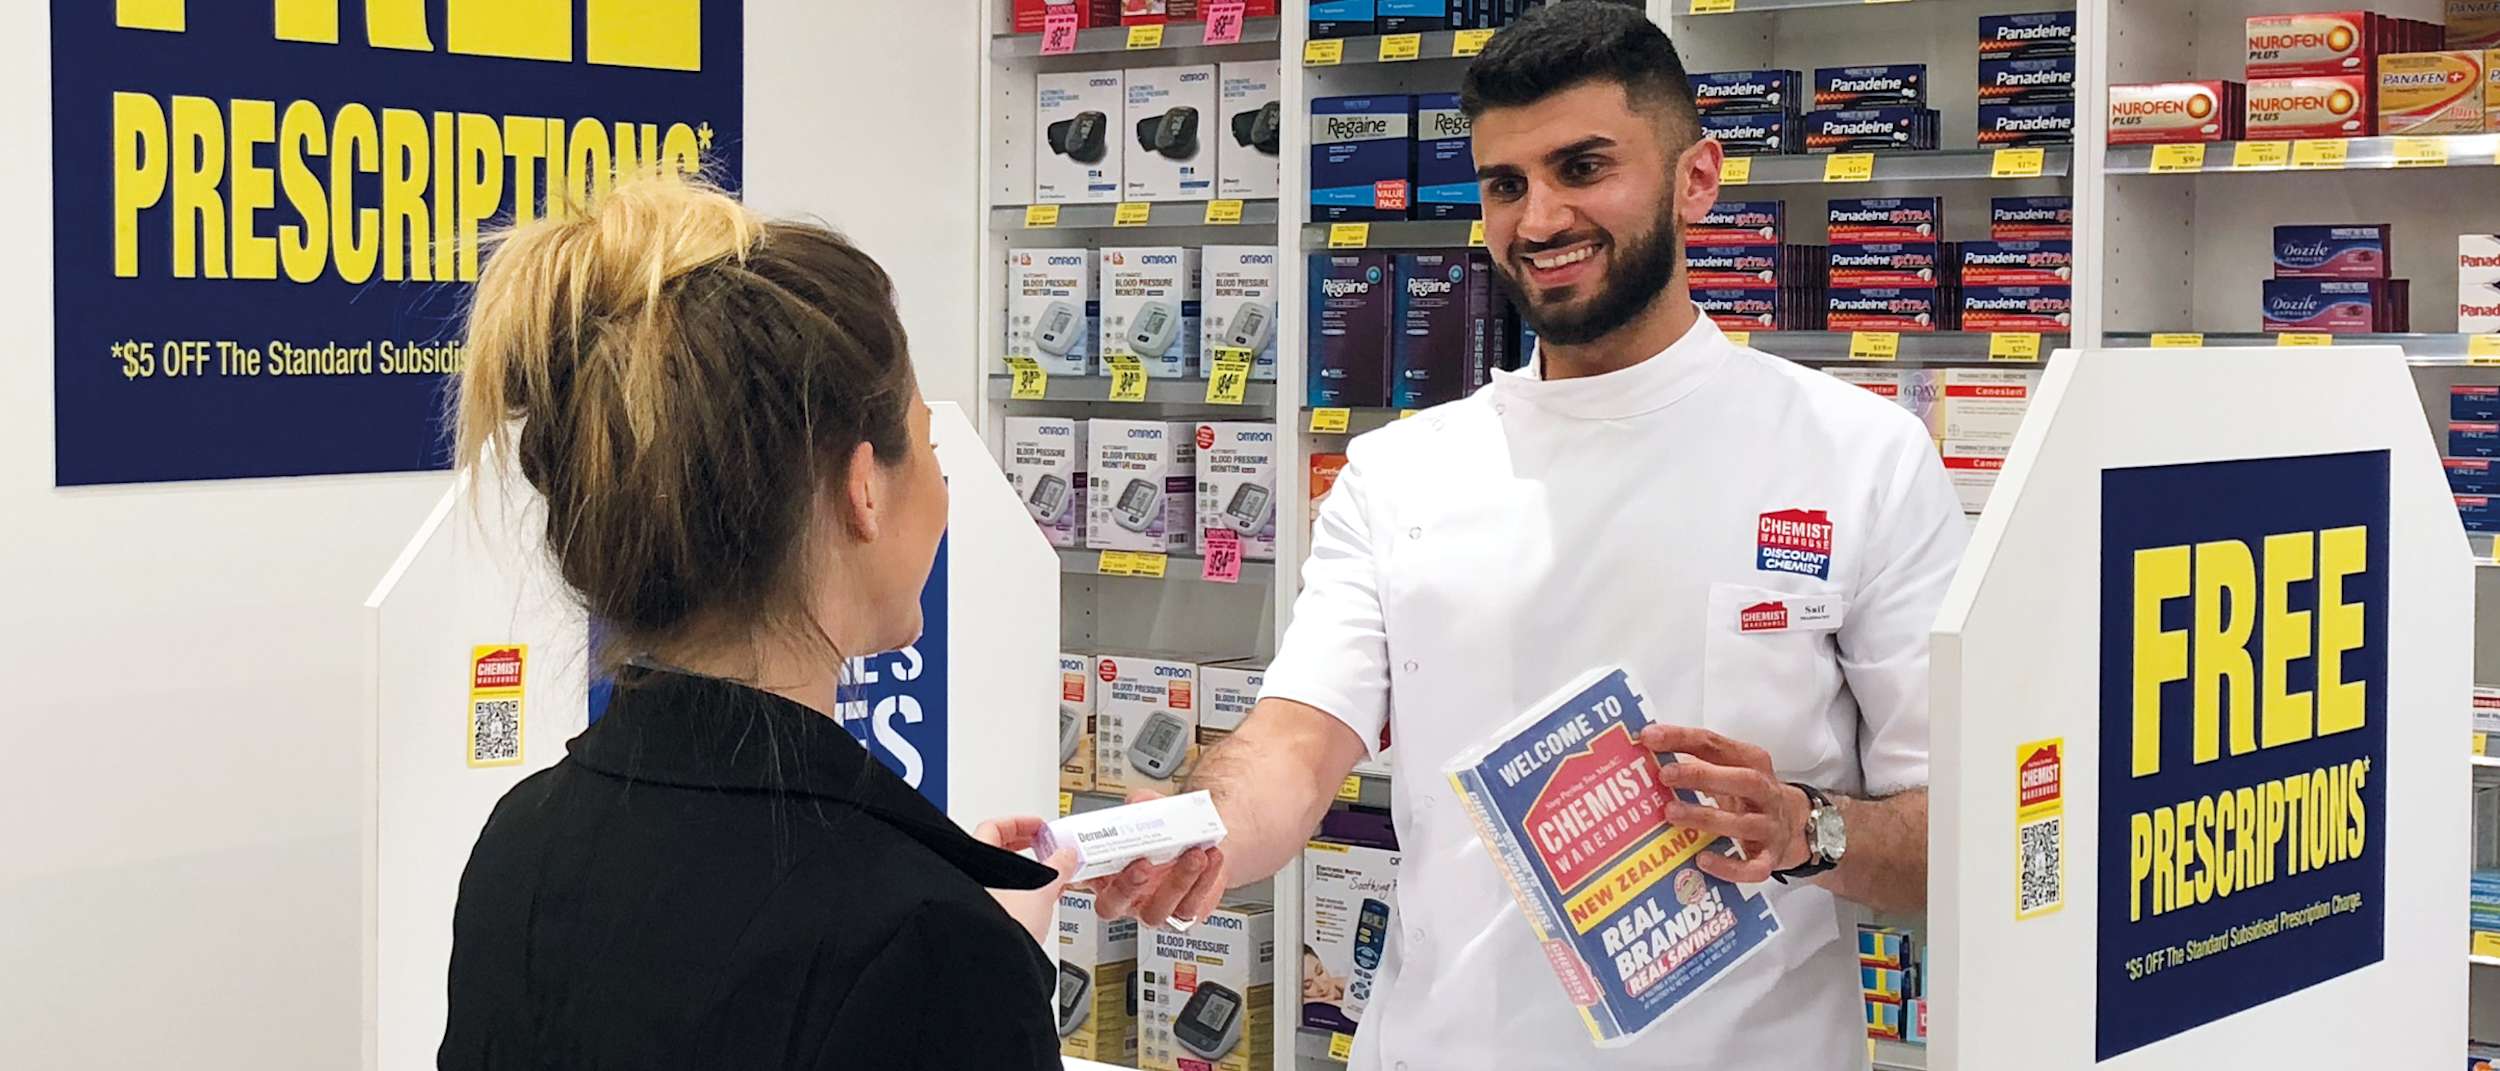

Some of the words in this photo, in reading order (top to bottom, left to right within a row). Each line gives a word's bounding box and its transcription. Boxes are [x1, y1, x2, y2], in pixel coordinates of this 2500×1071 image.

[1997, 24, 2071, 41] Panadeine
[2249, 34, 2325, 50] NUROFEN
[2249, 49, 2279, 60] PLUS
[1831, 78, 1901, 92] Panadeine
[1996, 70, 2071, 87] Panadeine
[2383, 73, 2446, 85] PANAFEN
[1698, 81, 1765, 97] Panadeine
[2112, 101, 2184, 116] NUROFEN
[2249, 97, 2325, 113] NUROFEN
[1435, 113, 1472, 135] Rega
[1996, 116, 2071, 132] Panadeine
[2112, 116, 2142, 125] PLUS
[2249, 112, 2279, 123] PLUS
[1328, 117, 1386, 139] Regaine
[1822, 120, 1894, 136] Panadeine
[1831, 208, 1888, 222] Panadeine
[1994, 208, 2055, 221] Panadeine
[1048, 256, 1081, 266] OMRON
[1142, 255, 1177, 264] OMRON
[1240, 255, 1273, 264] OMRON
[1686, 255, 1733, 267] anadeine
[1832, 253, 1890, 267] Panadeine
[1965, 252, 2026, 265] Panadeine
[1322, 279, 1368, 297] Regaine
[1408, 278, 1451, 297] Regaine
[1830, 298, 1888, 312] Panadeine
[1966, 297, 2026, 310] Panadeine
[2273, 294, 2318, 310] Dozile
[163, 340, 211, 377] OFF
[216, 340, 260, 376] The
[268, 340, 372, 375] Standard
[1039, 426, 1069, 436] OMRON
[1128, 429, 1161, 439] OMRON
[1237, 432, 1272, 441] OMRON
[1973, 459, 2004, 467] Canes
[1761, 517, 1831, 540] CHEMIST
[1760, 533, 1829, 550] WAREHOUSE
[1763, 547, 1827, 564] DISCOUNT
[1766, 559, 1822, 574] CHEMIST
[1743, 610, 1786, 622] CHEMIST
[2132, 525, 2367, 779] FREE
[477, 662, 520, 675] CHEMIST
[1060, 659, 1084, 670] RON
[1155, 665, 1191, 678] OMRON
[1499, 715, 1593, 788] WELCOME
[1593, 695, 1622, 727] TO
[2021, 764, 2059, 789] CHEMIST
[1538, 756, 1653, 854] CHEMIST
[1077, 826, 1119, 843] DermAid
[1555, 792, 1663, 874] WAREHOUSE
[1571, 885, 1616, 925] NEW
[1616, 827, 1699, 892] ZEALAND
[1060, 896, 1091, 910] MRON
[1060, 921, 1079, 934] SURE
[1602, 897, 1666, 957] REAL
[1615, 886, 1724, 981] BRANDS!
[2146, 951, 2165, 975] OFF
[2167, 946, 2184, 967] The
[2186, 930, 2228, 962] Standard
[2230, 915, 2278, 947] Subsidised
[2280, 901, 2330, 931] Prescription
[2331, 892, 2363, 913] Charge.
[1157, 934, 1184, 947] BLOOD
[1186, 937, 1230, 954] PRESSURE
[1157, 947, 1194, 961] MONITOR
[1629, 954, 1668, 994] REAL
